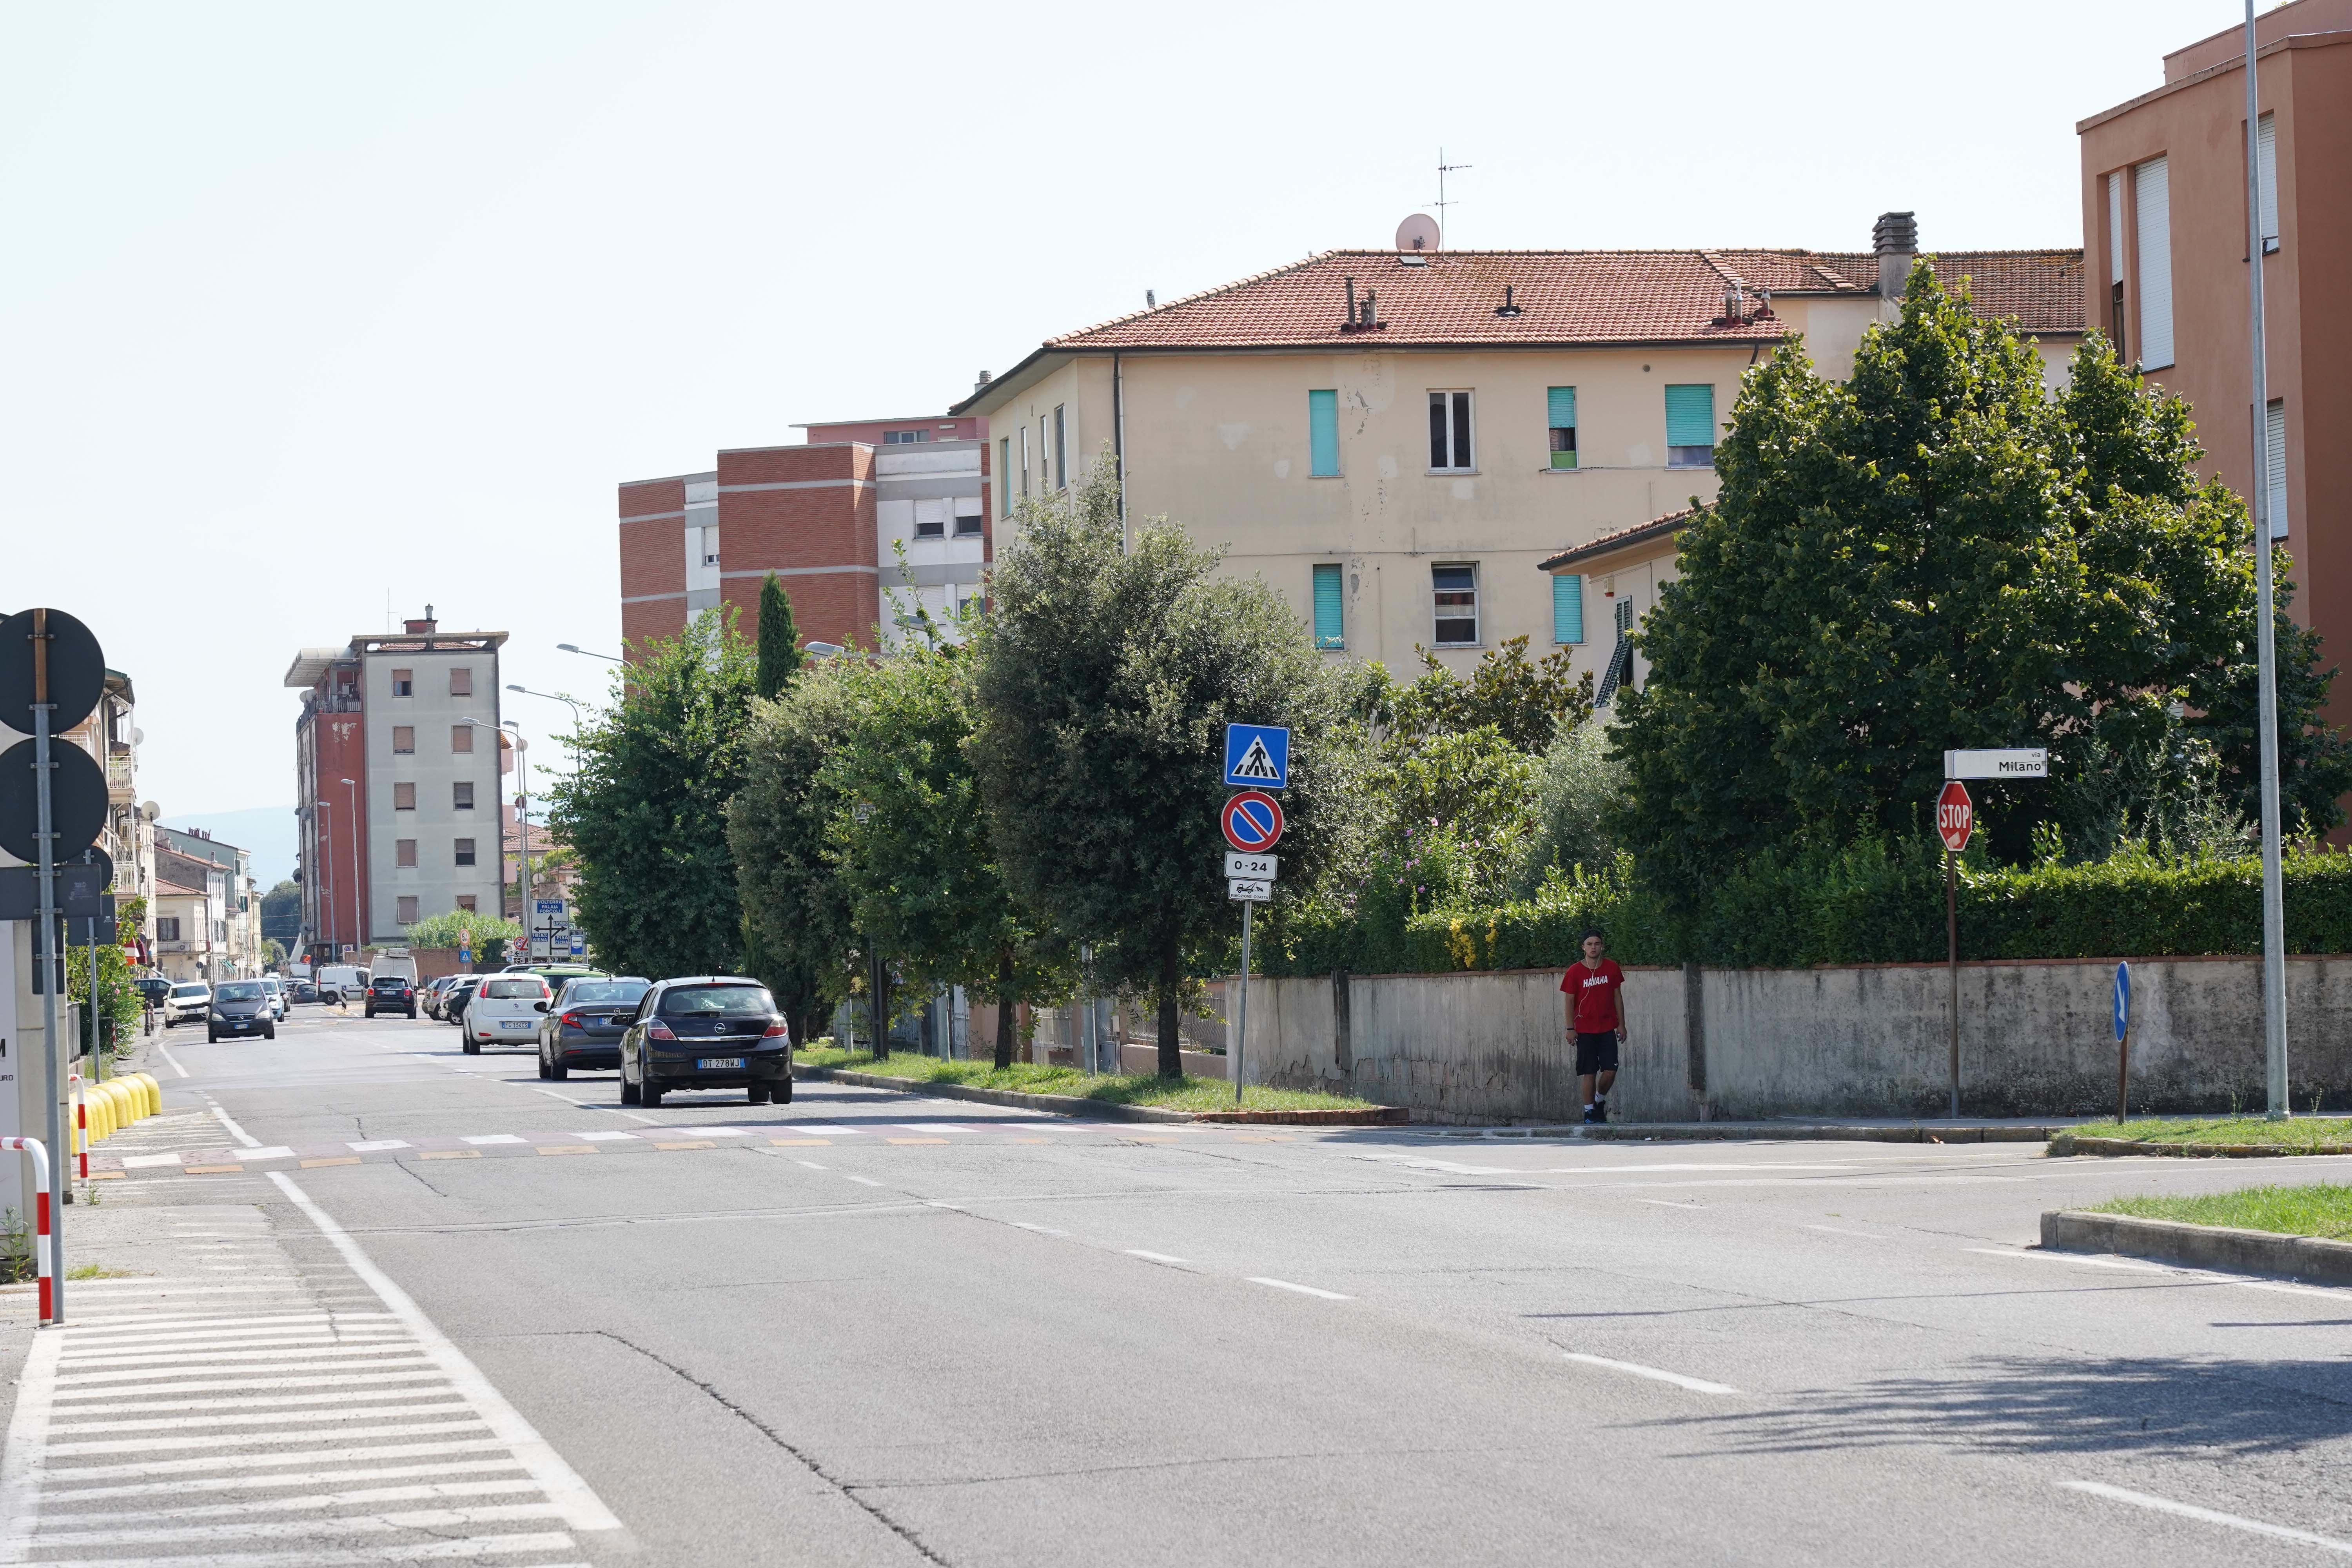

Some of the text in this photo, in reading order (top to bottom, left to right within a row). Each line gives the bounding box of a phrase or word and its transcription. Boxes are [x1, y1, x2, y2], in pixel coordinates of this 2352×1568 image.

[1999, 762, 2041, 771] Milano
[1940, 804, 1969, 829] STOP
[1583, 975, 1608, 987] HAVANA
